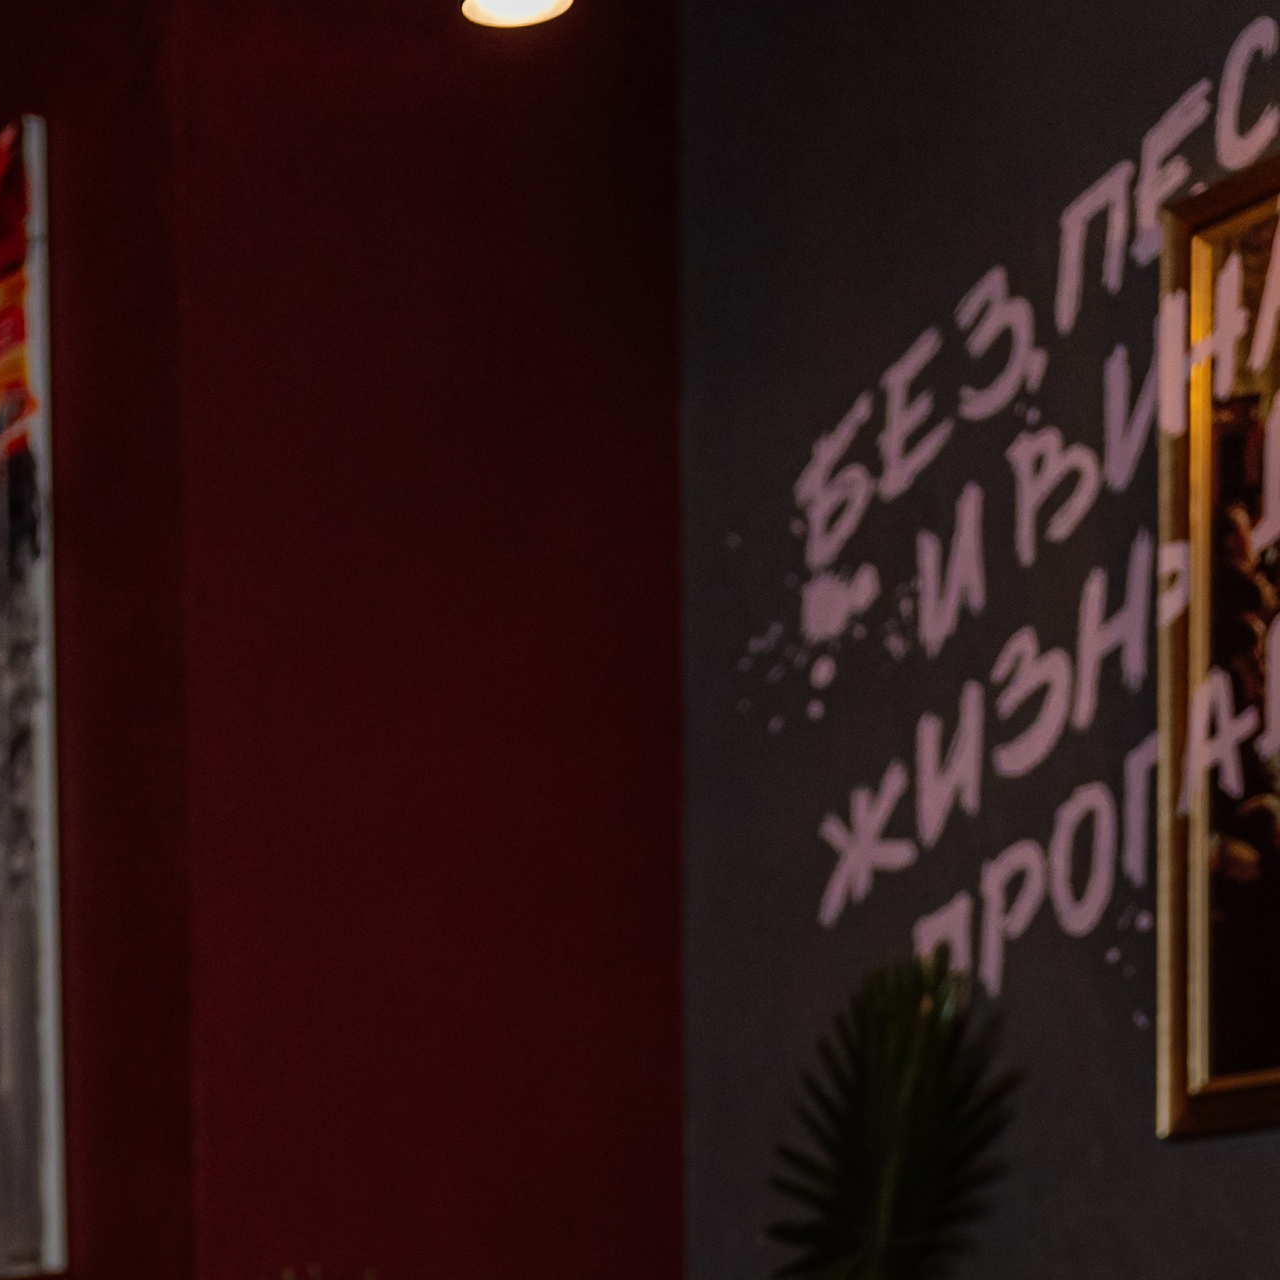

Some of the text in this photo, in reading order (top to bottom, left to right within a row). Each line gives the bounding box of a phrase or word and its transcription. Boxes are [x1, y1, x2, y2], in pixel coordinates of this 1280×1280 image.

[793, 264, 1047, 569] БЕЗ
[915, 481, 987, 658] И
[1005, 193, 1280, 567] ВИН
